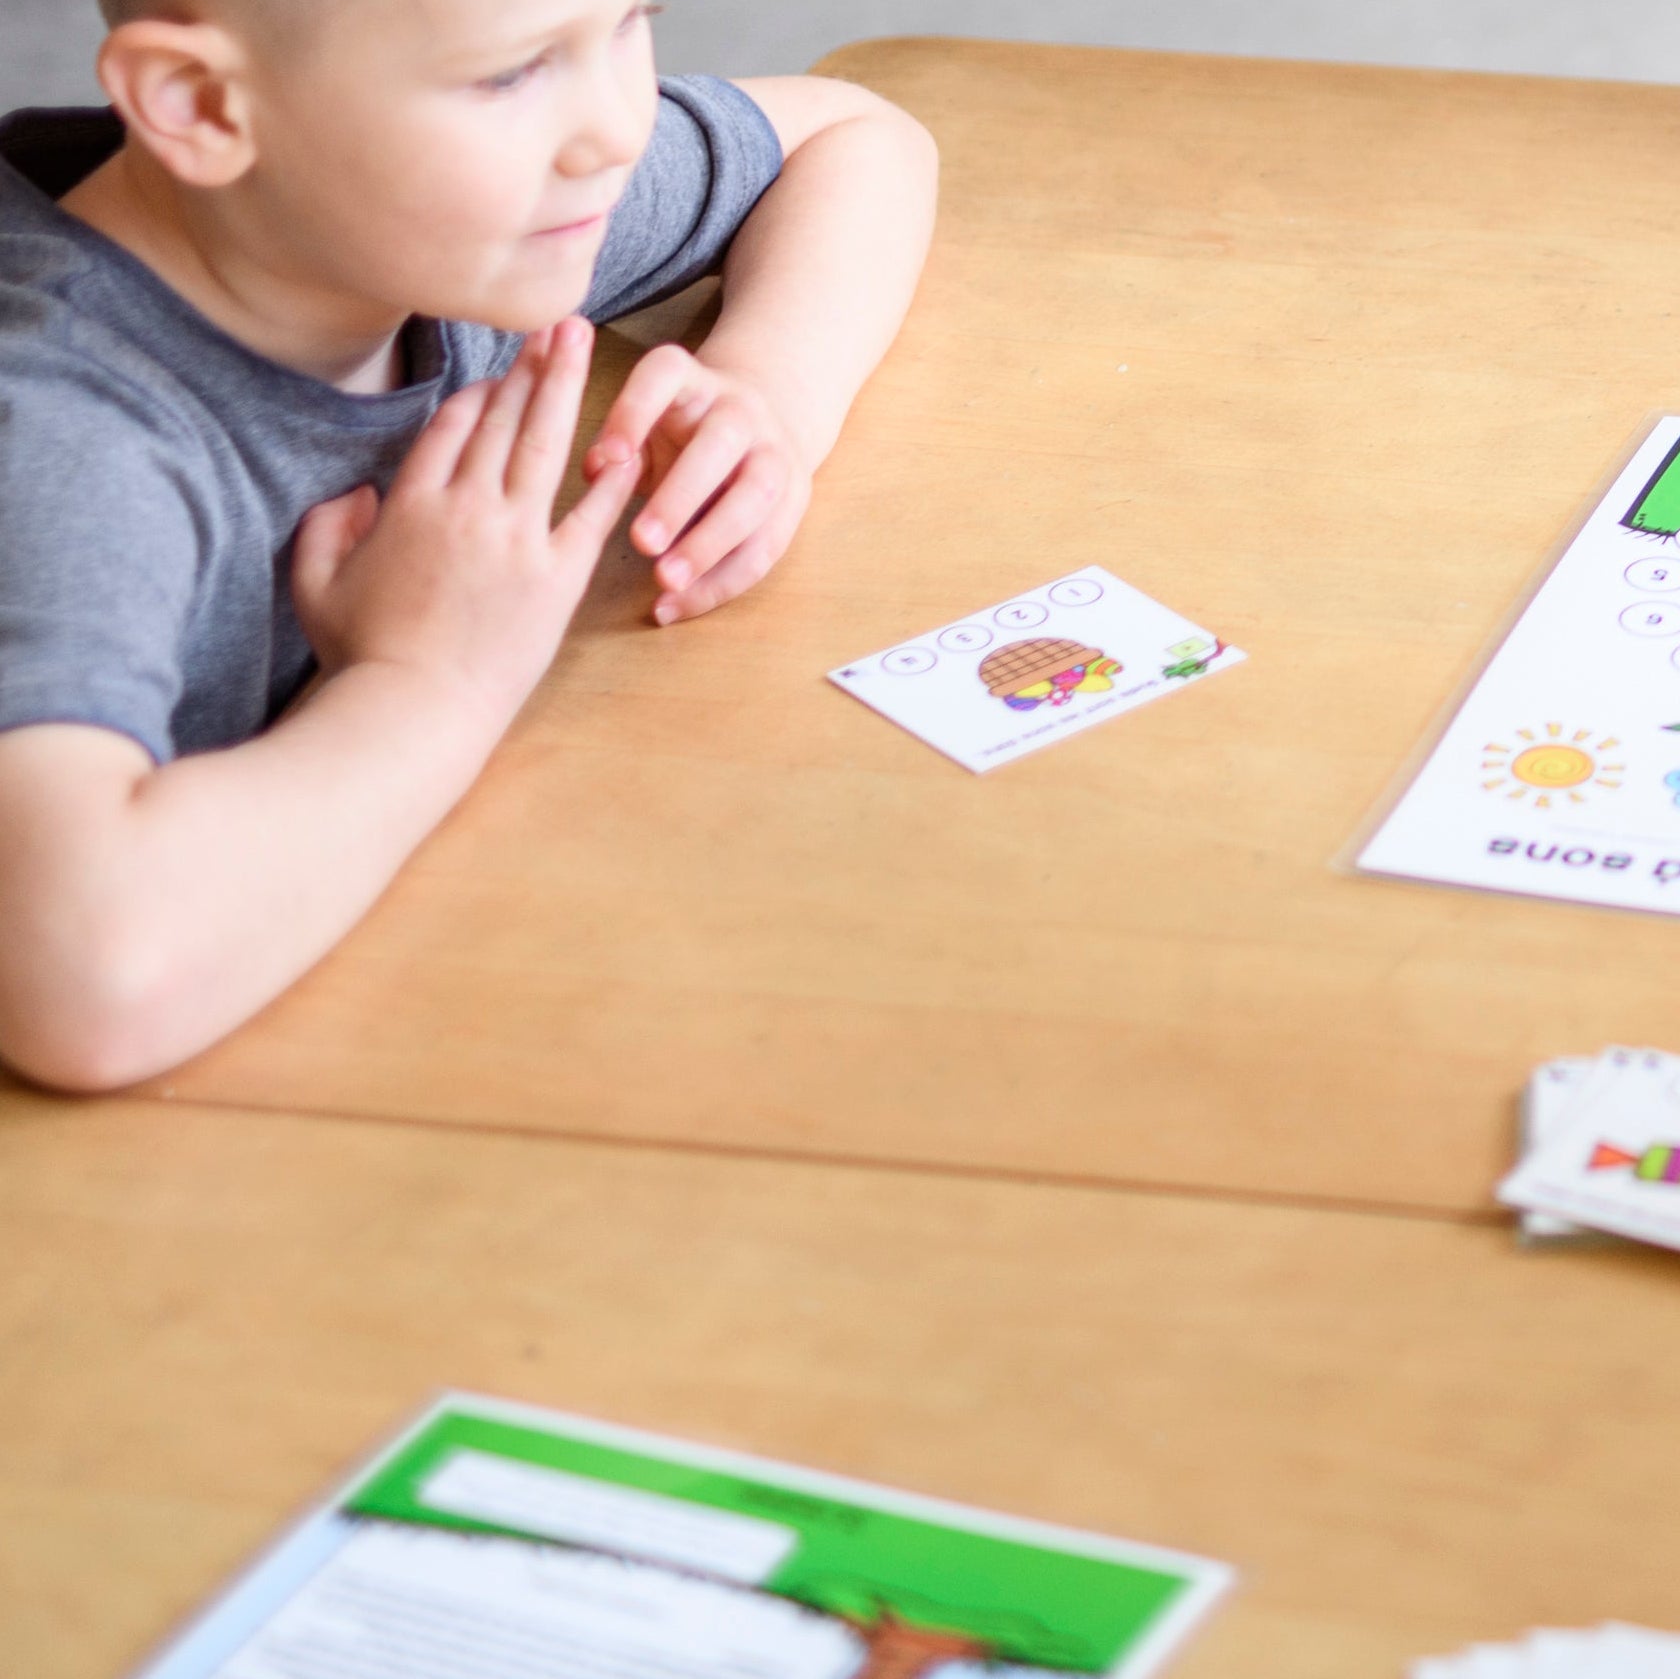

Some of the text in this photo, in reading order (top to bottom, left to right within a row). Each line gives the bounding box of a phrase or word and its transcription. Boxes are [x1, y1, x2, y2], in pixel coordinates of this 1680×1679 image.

[1653, 569, 1667, 581] 5
[1648, 614, 1663, 625] 6
[1488, 839, 1633, 870] sons
